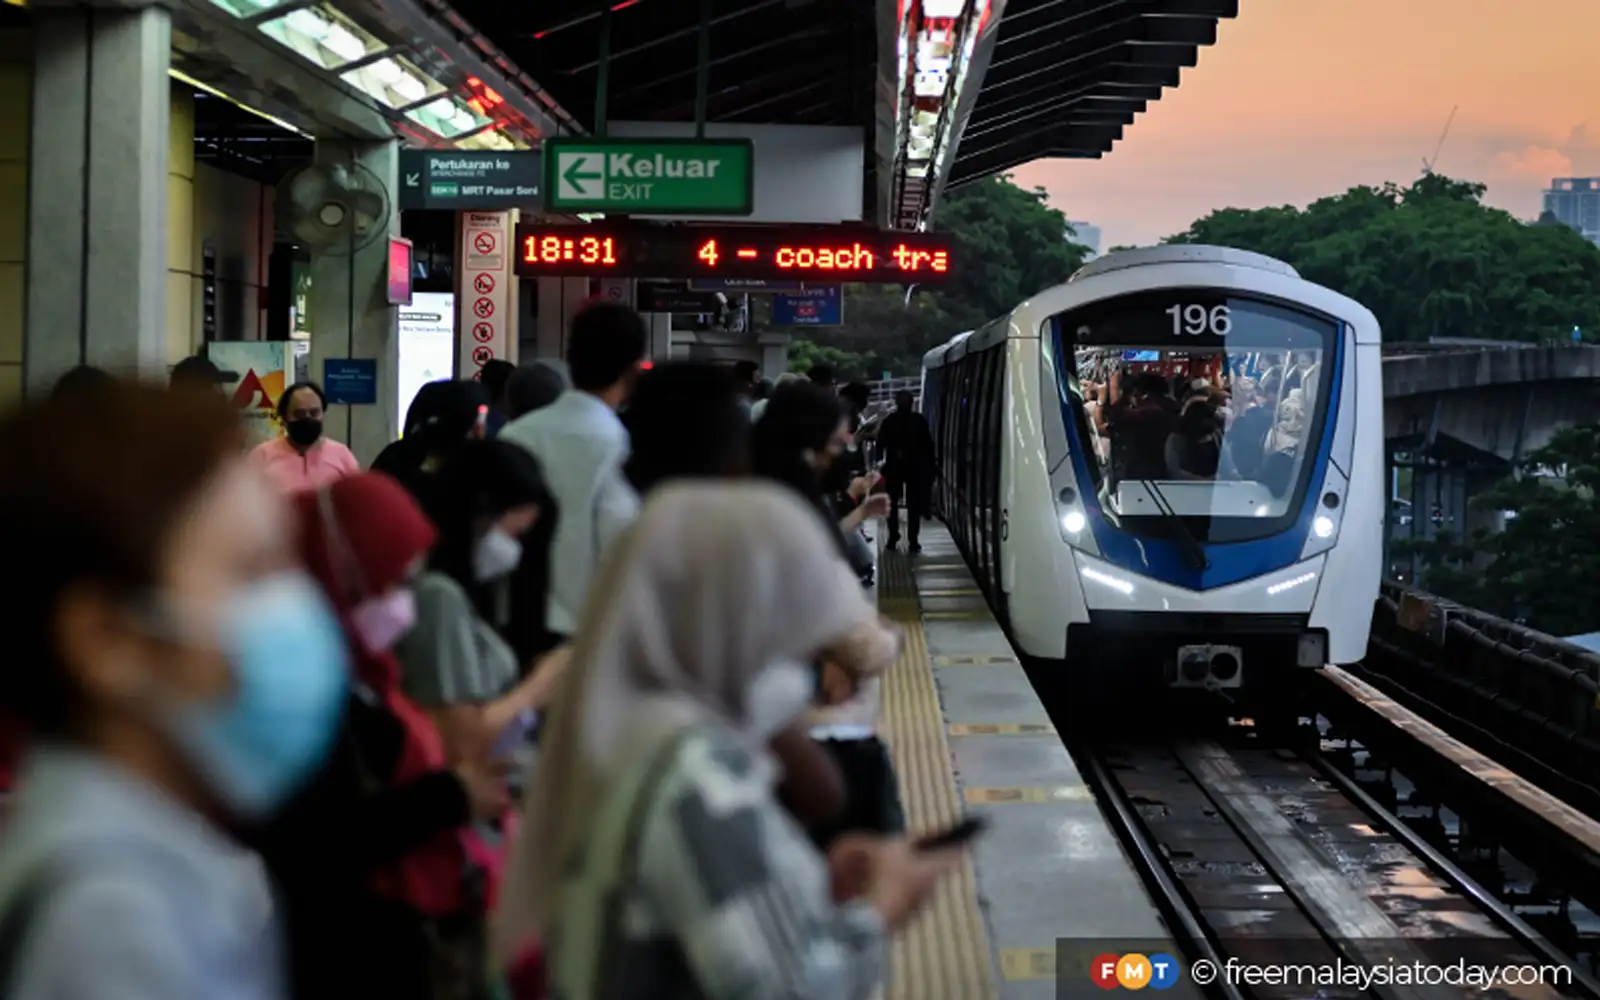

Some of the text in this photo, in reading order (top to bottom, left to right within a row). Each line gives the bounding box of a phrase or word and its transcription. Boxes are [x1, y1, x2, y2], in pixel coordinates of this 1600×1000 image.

[430, 158, 511, 170] Pertukaran ke
[609, 153, 720, 178] Keluar
[461, 185, 485, 196] MRT
[486, 185, 515, 196] Pasar
[516, 185, 538, 196] Seni
[608, 183, 654, 200] EXIT
[524, 235, 617, 264] 18:31
[699, 239, 718, 266] 4
[776, 243, 873, 270] coach
[893, 244, 947, 272] tra
[1165, 304, 1233, 336] 196
